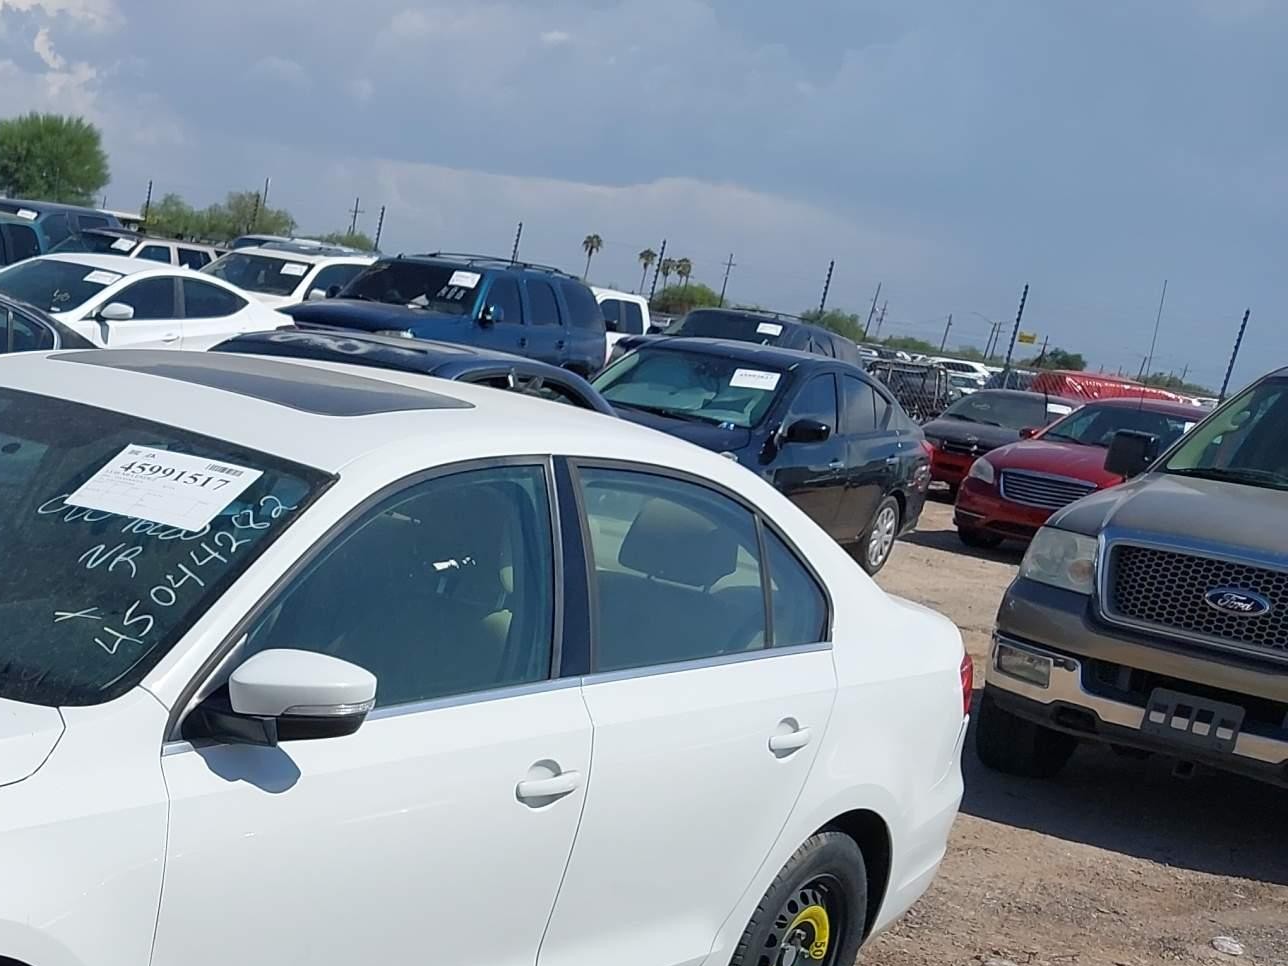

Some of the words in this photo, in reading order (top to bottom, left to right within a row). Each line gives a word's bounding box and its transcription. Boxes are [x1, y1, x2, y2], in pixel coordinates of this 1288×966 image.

[119, 461, 232, 491] 45991517
[78, 543, 143, 579] NR
[1217, 593, 1255, 611] Ford
